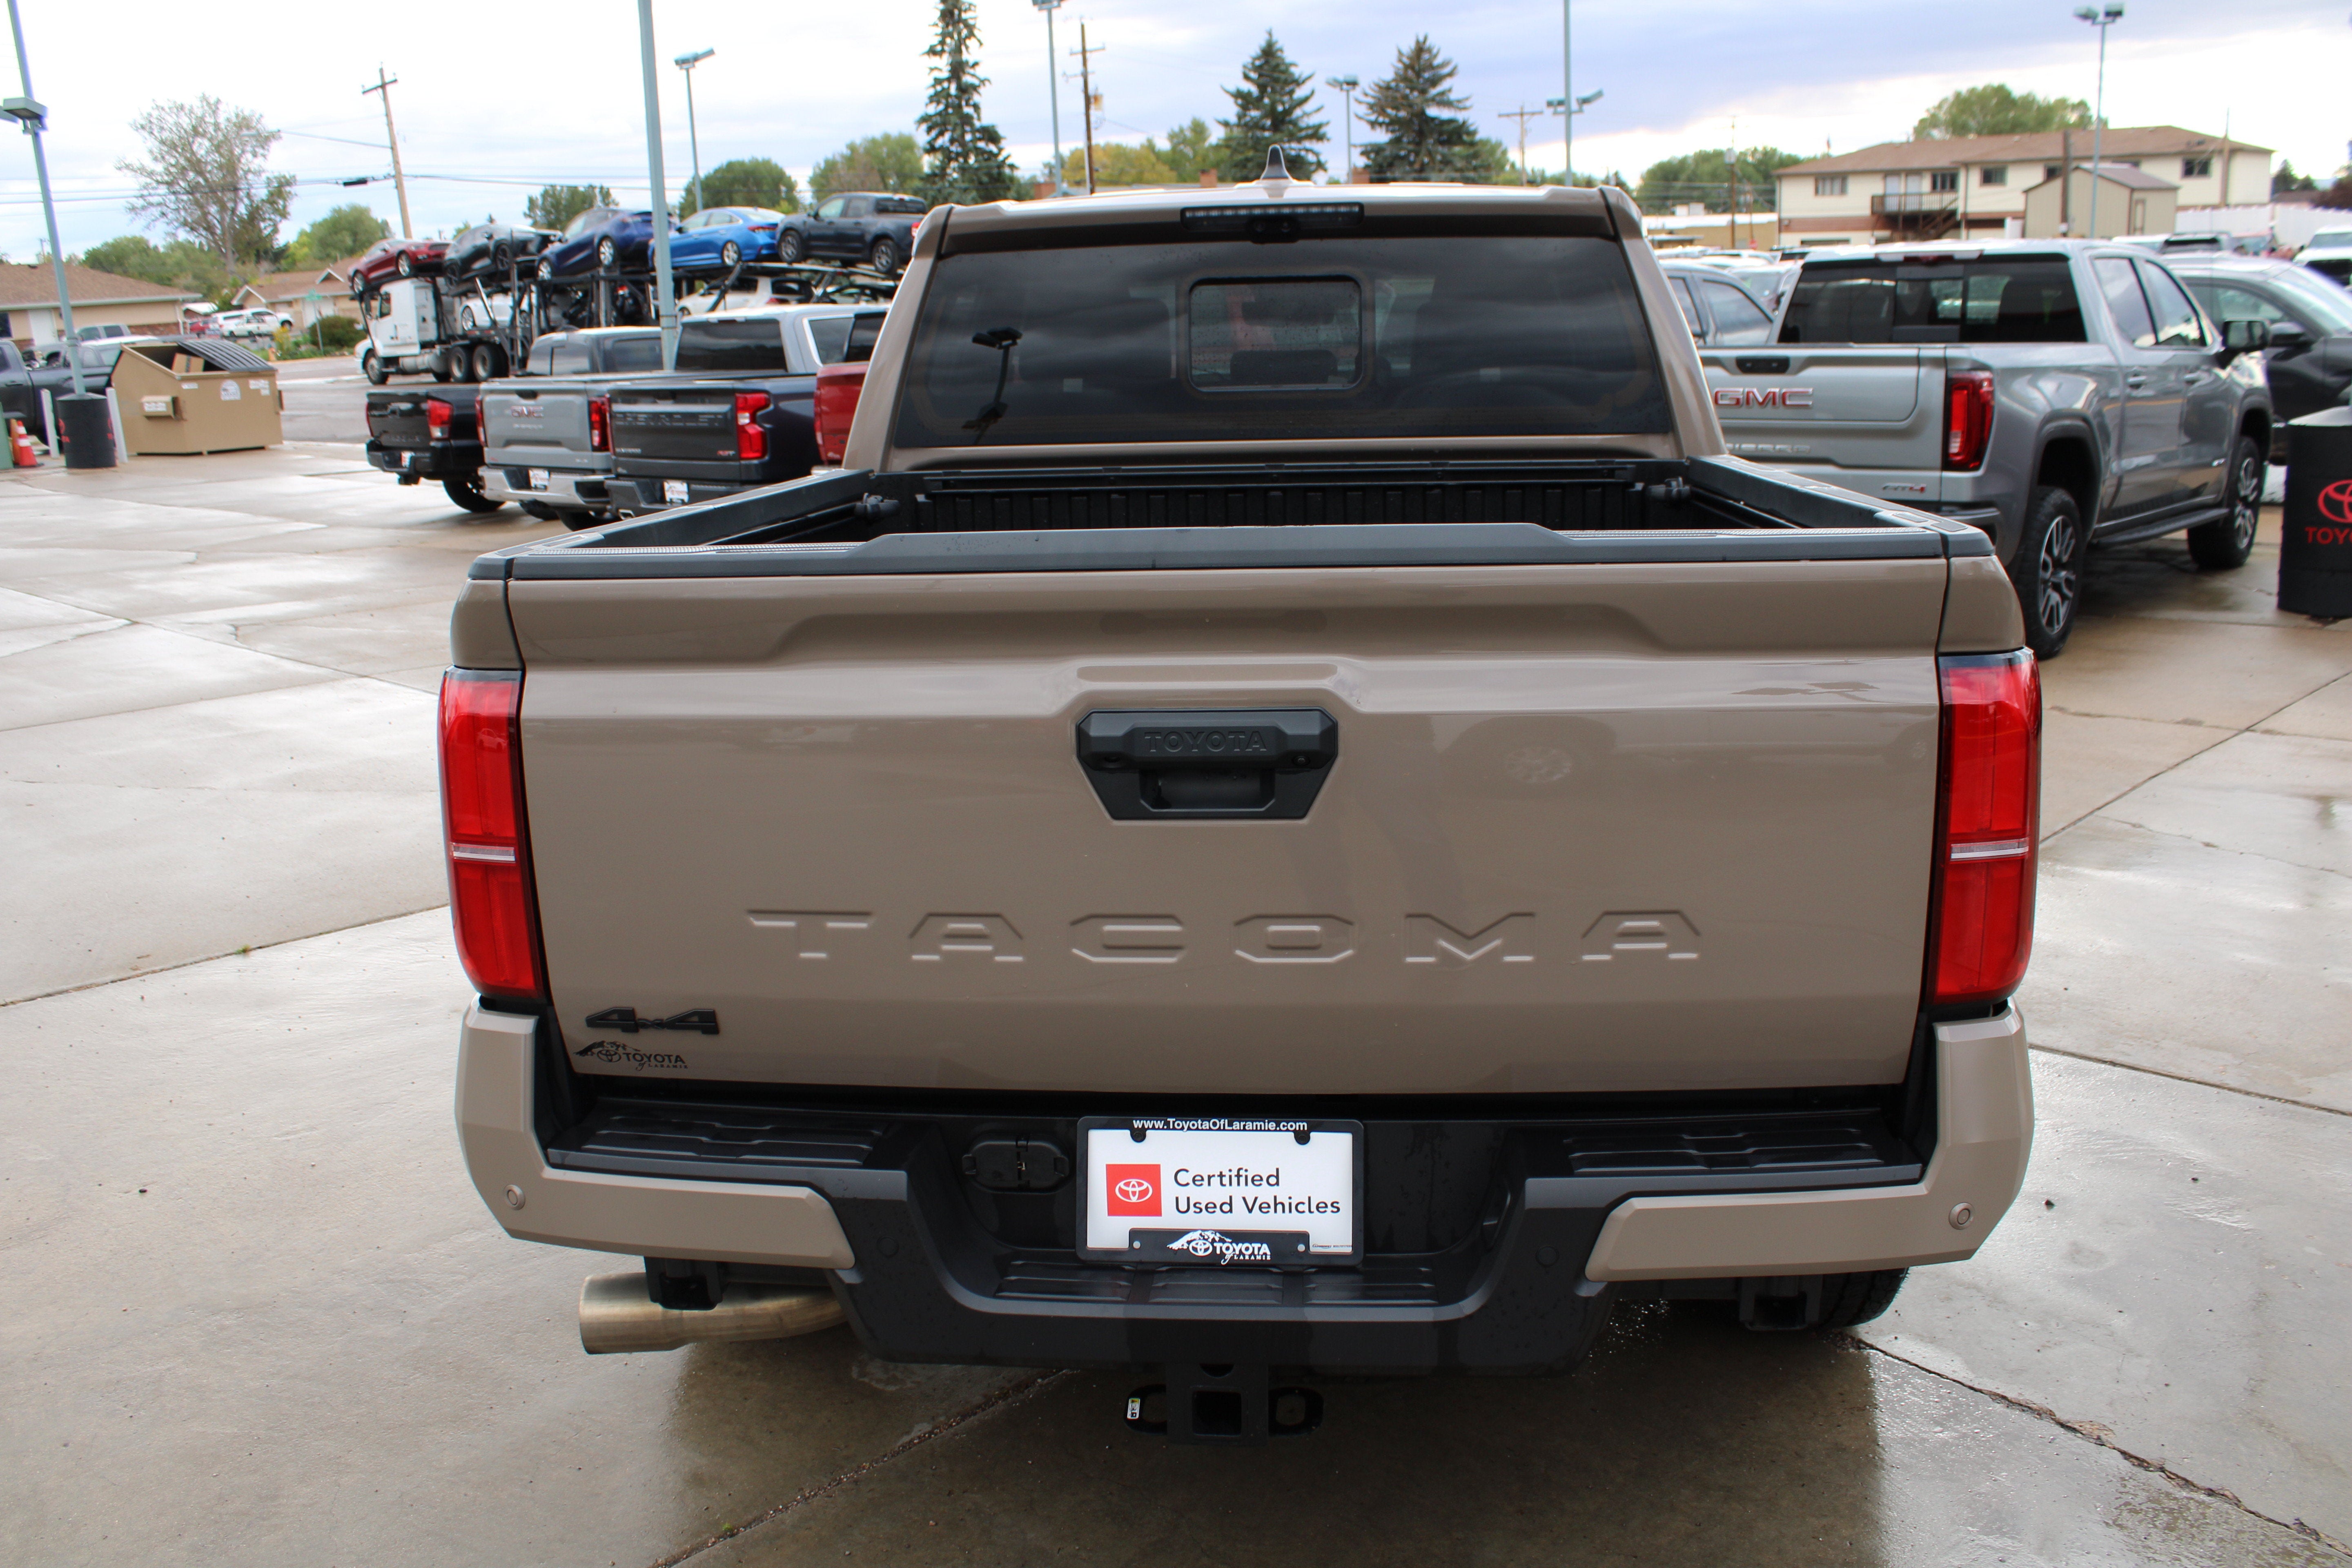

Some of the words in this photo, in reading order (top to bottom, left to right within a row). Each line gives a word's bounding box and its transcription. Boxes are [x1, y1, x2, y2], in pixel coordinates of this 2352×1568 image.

[1713, 388, 1813, 408] GMC
[2304, 526, 2352, 545] TOY
[1144, 731, 1267, 752] TOYOTA
[747, 910, 1700, 962] TACOMA
[623, 1052, 686, 1064] TOYOTA
[635, 1062, 647, 1071] of
[1133, 1118, 1307, 1132] www.ToyotaOfLaramie.com
[1174, 1167, 1280, 1187] Certified
[1175, 1196, 1233, 1214] Used
[1242, 1196, 1341, 1214] Vehicles
[1214, 1243, 1271, 1255] TOYOTA
[1221, 1252, 1235, 1265] of
